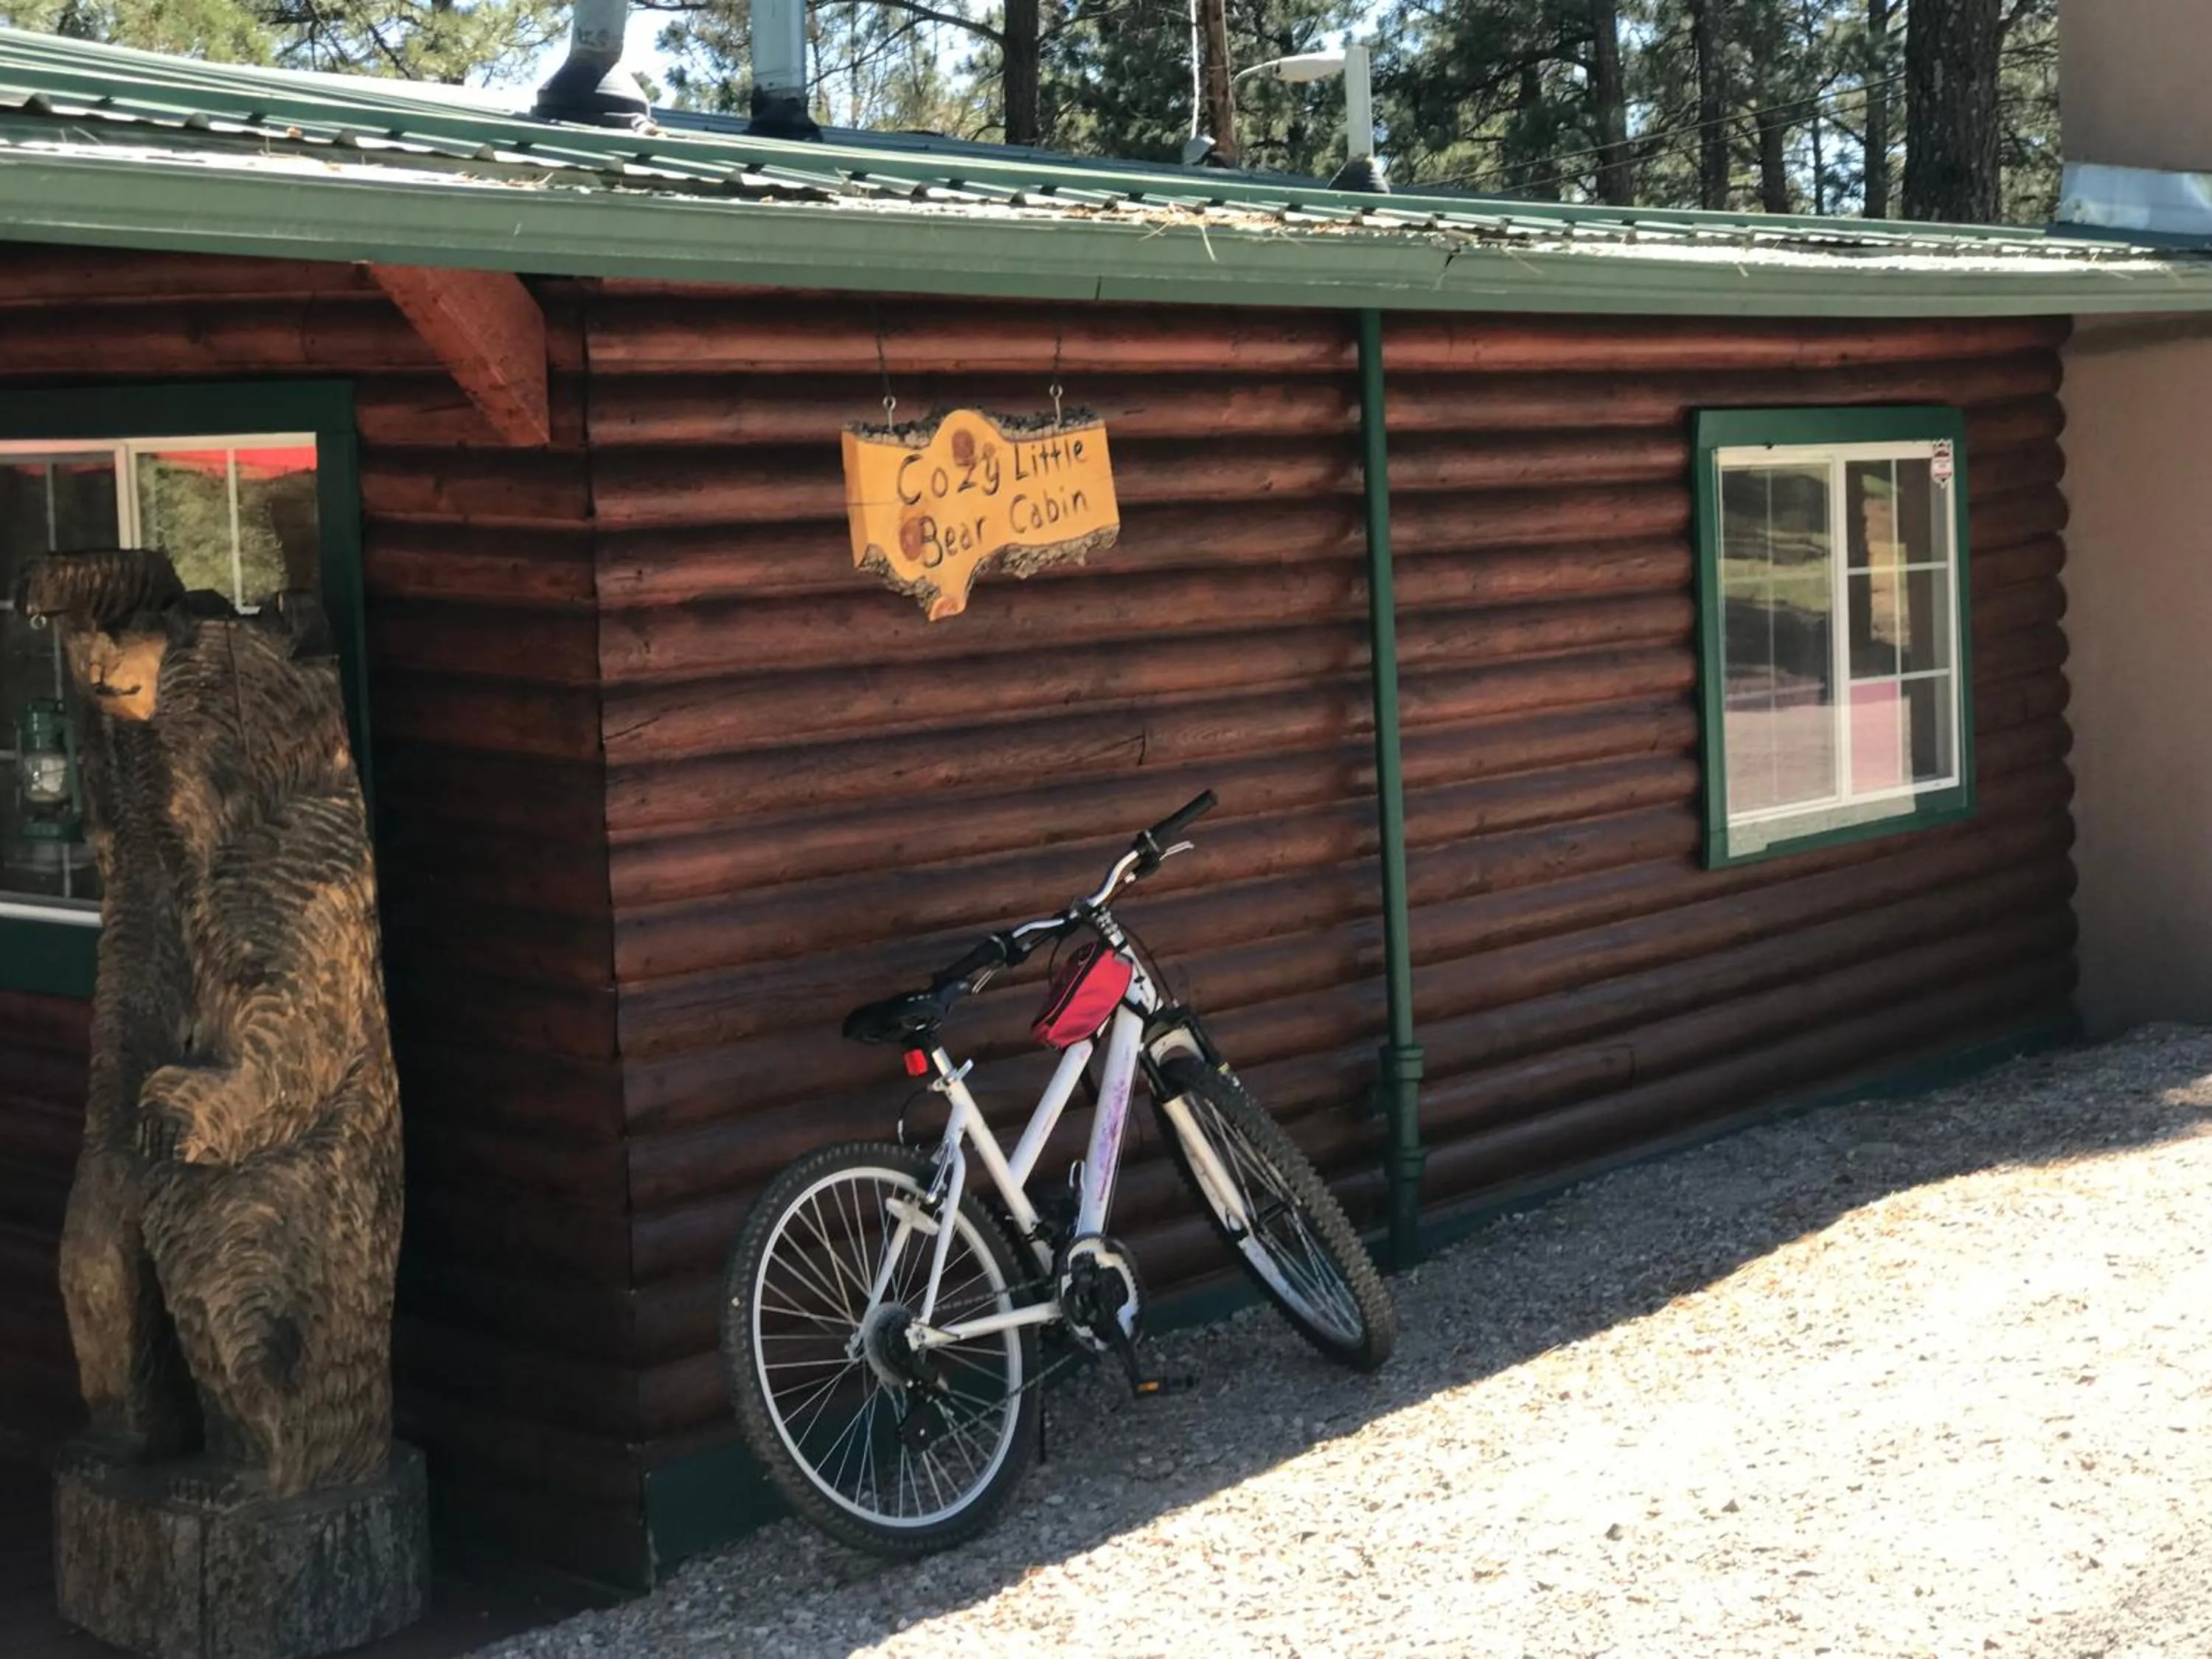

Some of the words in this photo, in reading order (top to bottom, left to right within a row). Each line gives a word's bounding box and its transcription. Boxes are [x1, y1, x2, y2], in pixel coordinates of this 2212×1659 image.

[897, 448, 1000, 505] Cozy
[1015, 437, 1088, 481] Little
[919, 515, 986, 568] Bear
[1009, 487, 1088, 534] Cabin
